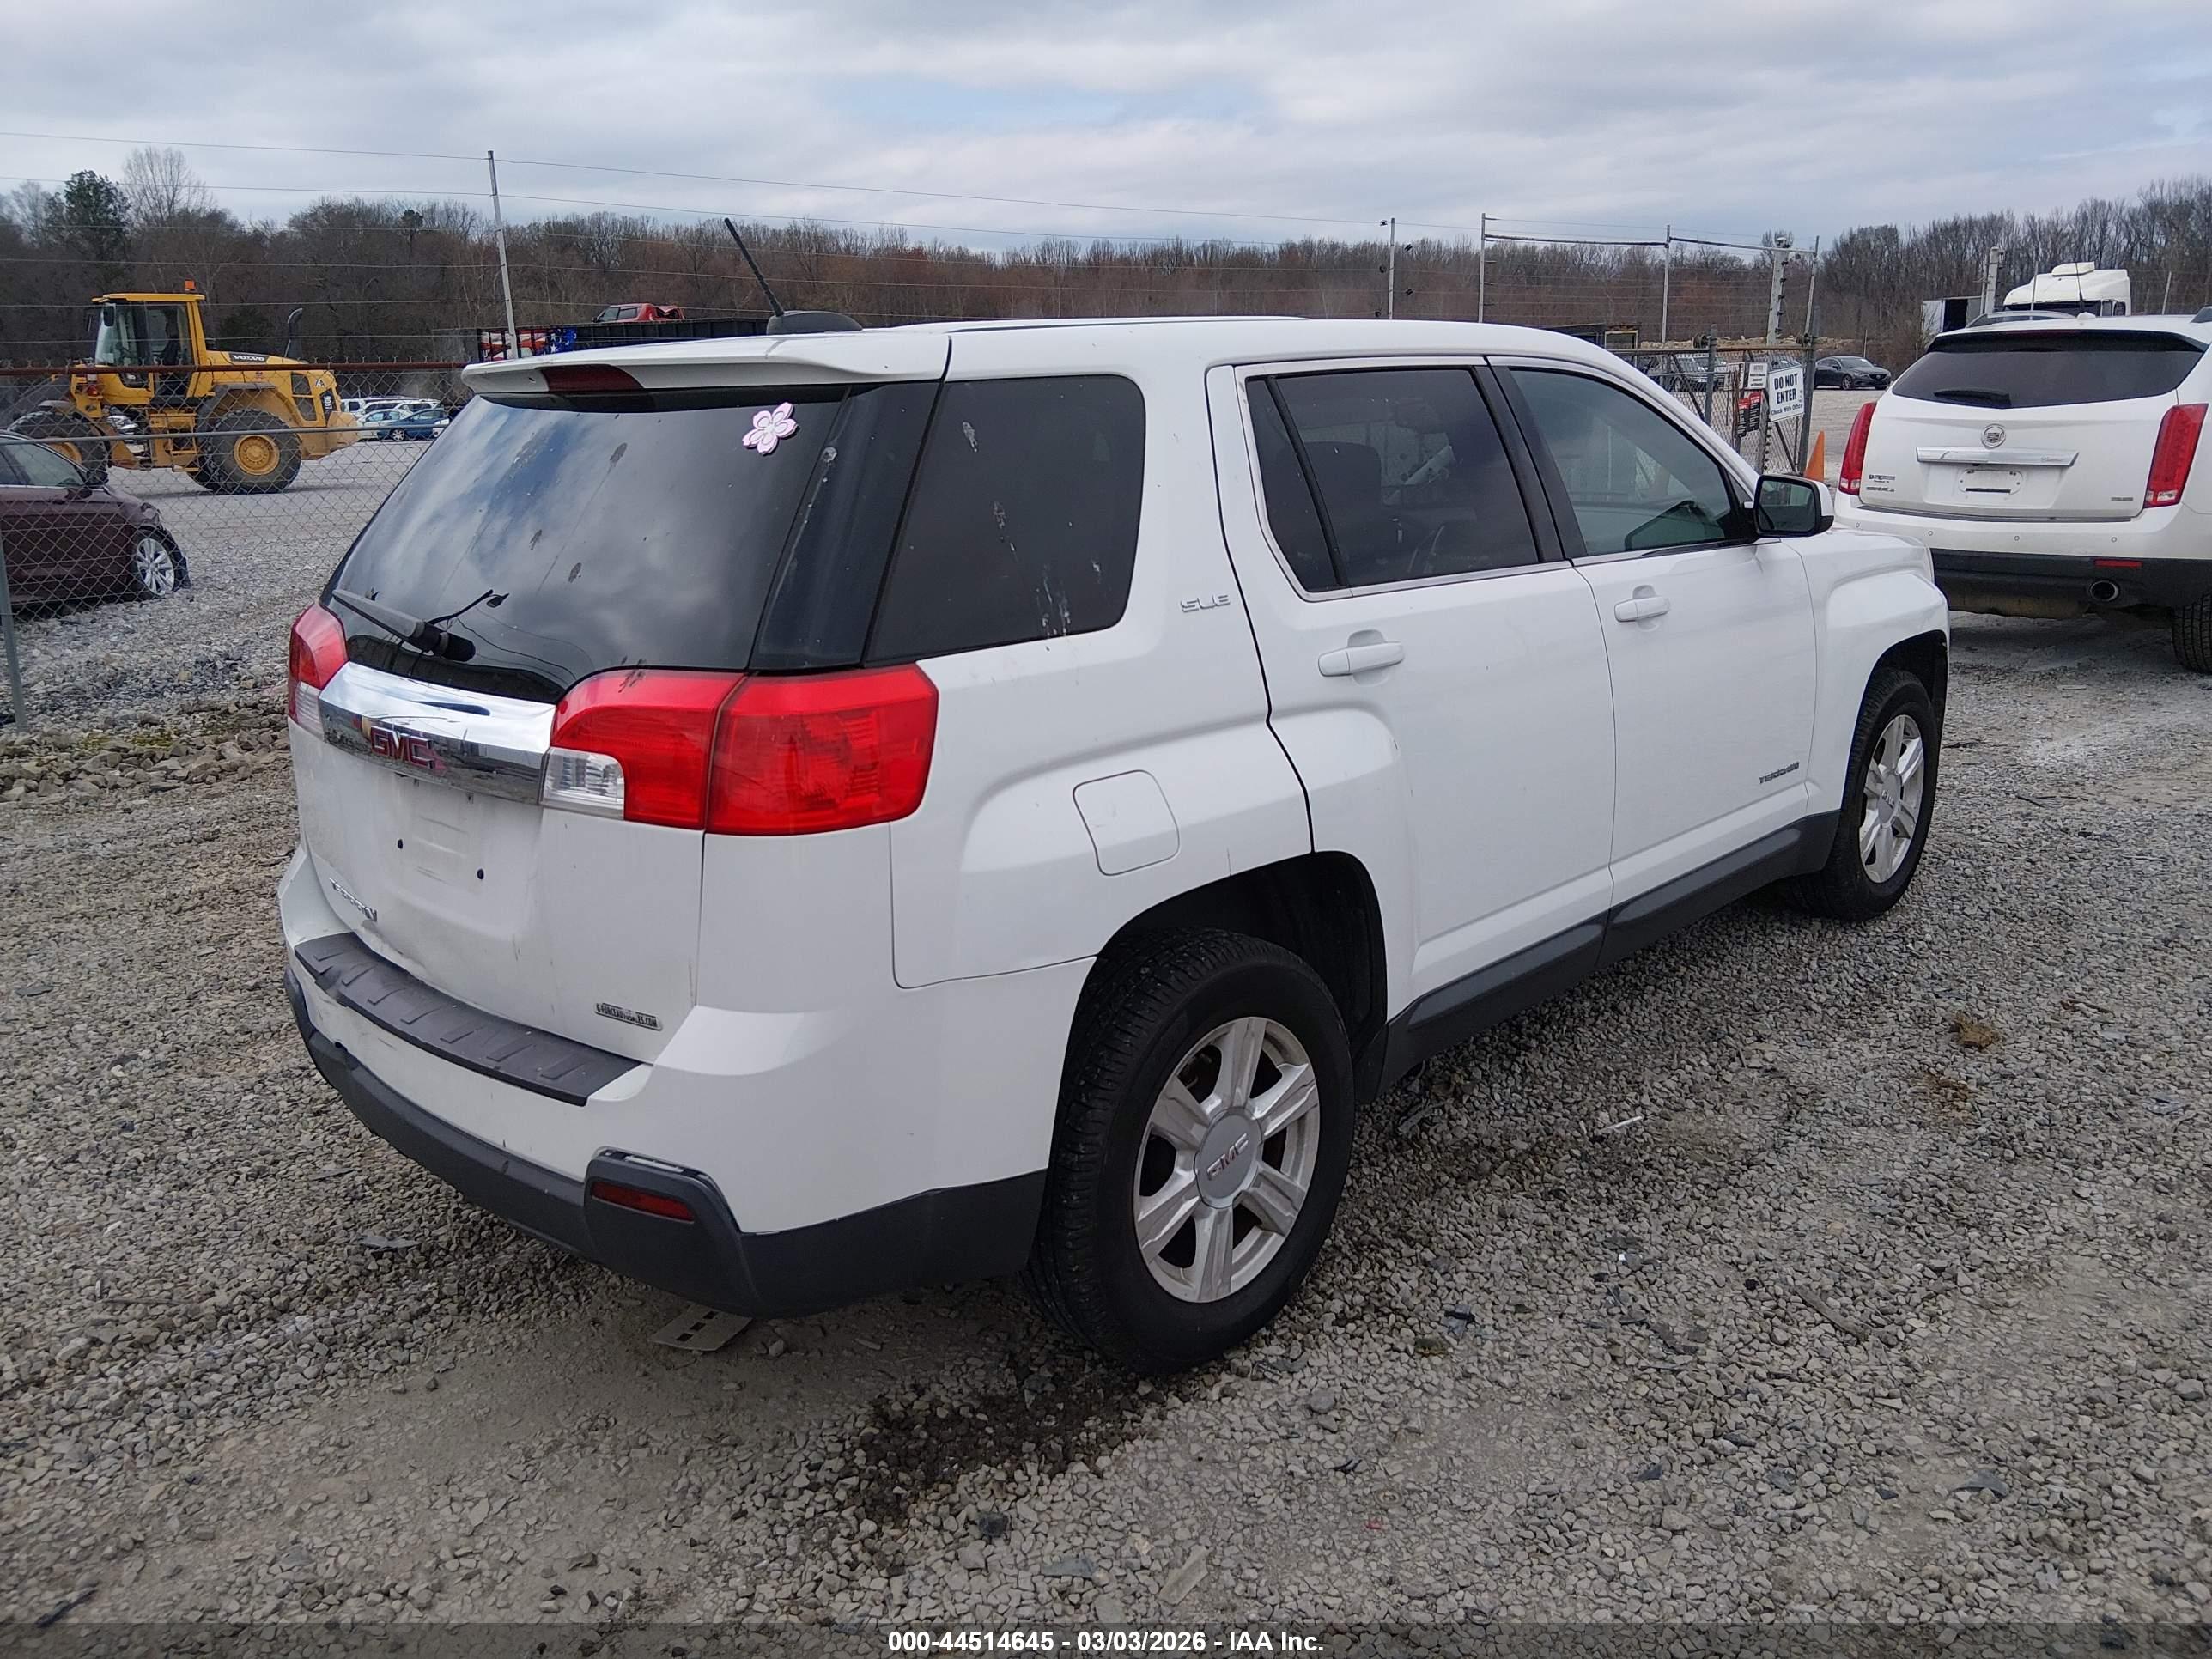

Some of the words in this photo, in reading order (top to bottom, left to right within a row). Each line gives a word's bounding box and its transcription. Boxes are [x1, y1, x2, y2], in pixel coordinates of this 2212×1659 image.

[1774, 376, 1784, 390] DO
[1785, 373, 1798, 386] NOT
[1777, 388, 1796, 404] ENTER
[1180, 594, 1231, 613] SLE
[370, 726, 434, 770] GMC
[1206, 1133, 1249, 1180] GMC
